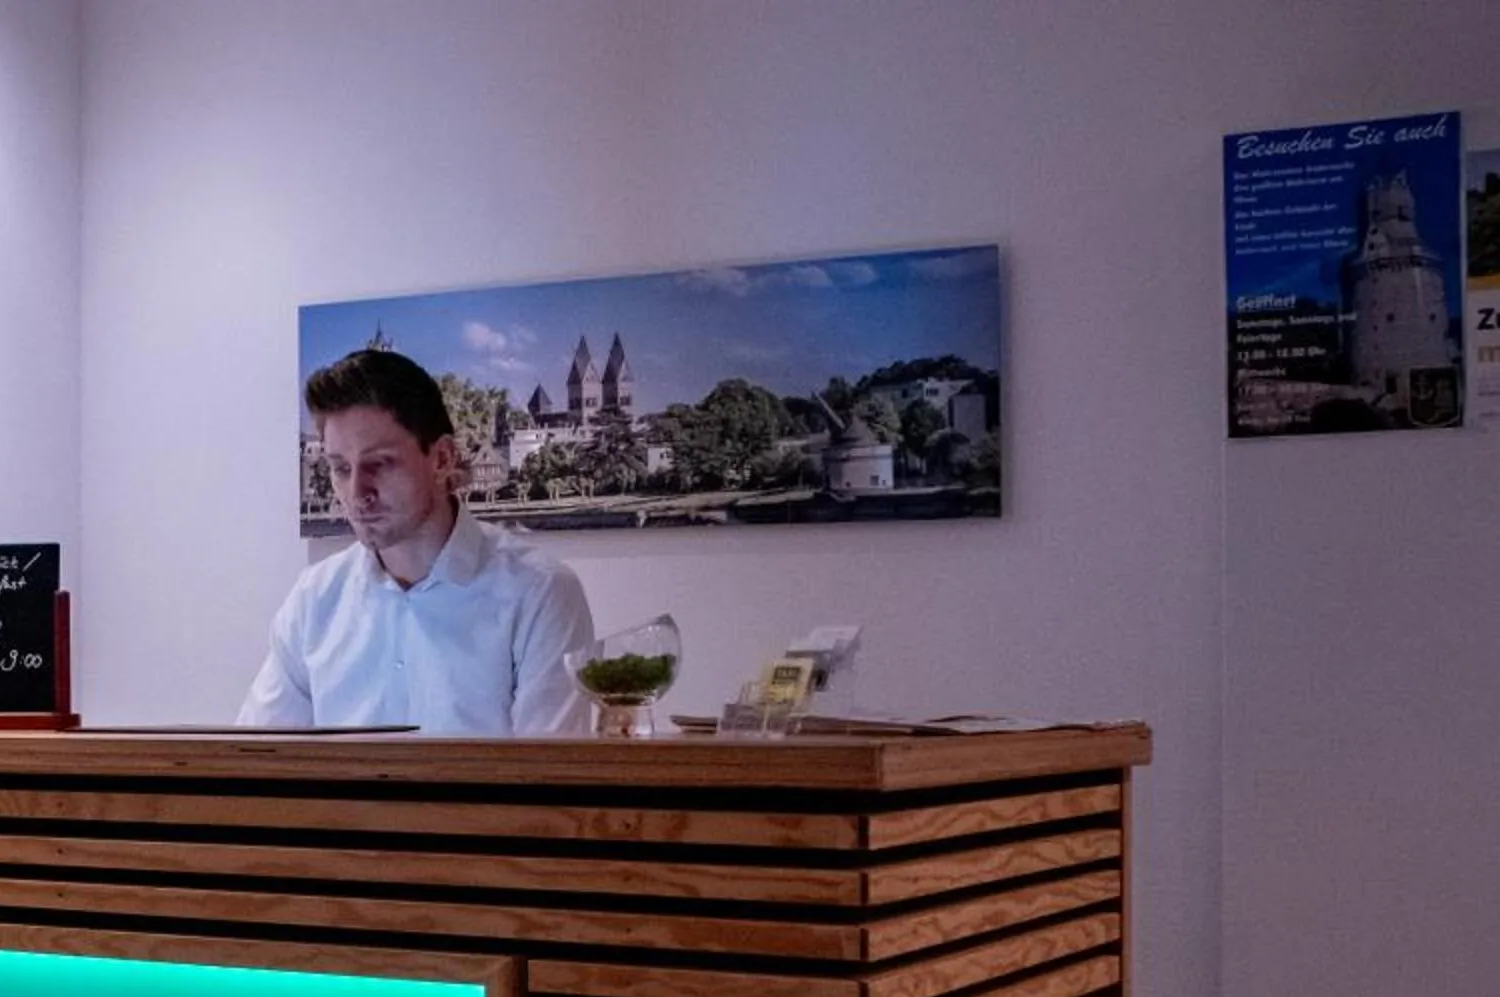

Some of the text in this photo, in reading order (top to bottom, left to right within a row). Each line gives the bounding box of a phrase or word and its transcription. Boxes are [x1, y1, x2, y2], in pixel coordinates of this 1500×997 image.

[1236, 114, 1447, 159] Besuchen Sie auch
[1477, 308, 1500, 330] Z
